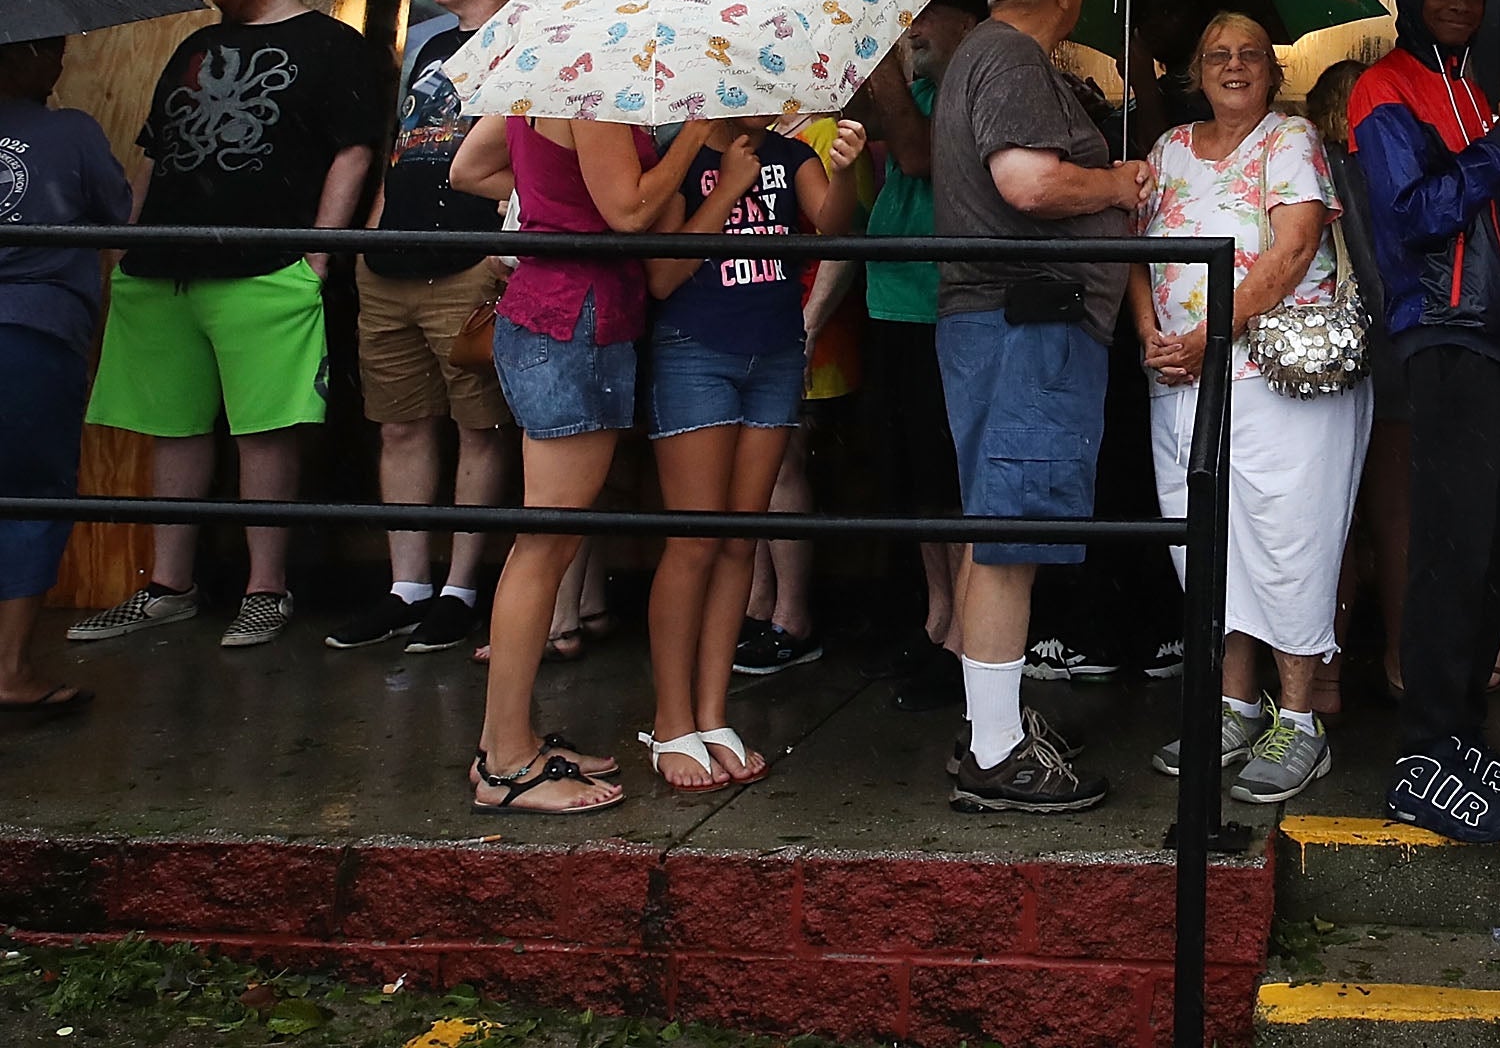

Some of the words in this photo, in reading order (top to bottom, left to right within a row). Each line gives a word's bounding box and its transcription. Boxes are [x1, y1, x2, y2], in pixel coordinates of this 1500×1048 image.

[14, 170, 26, 194] UNION
[720, 259, 787, 287] COLOR
[1395, 755, 1489, 827] AIR
